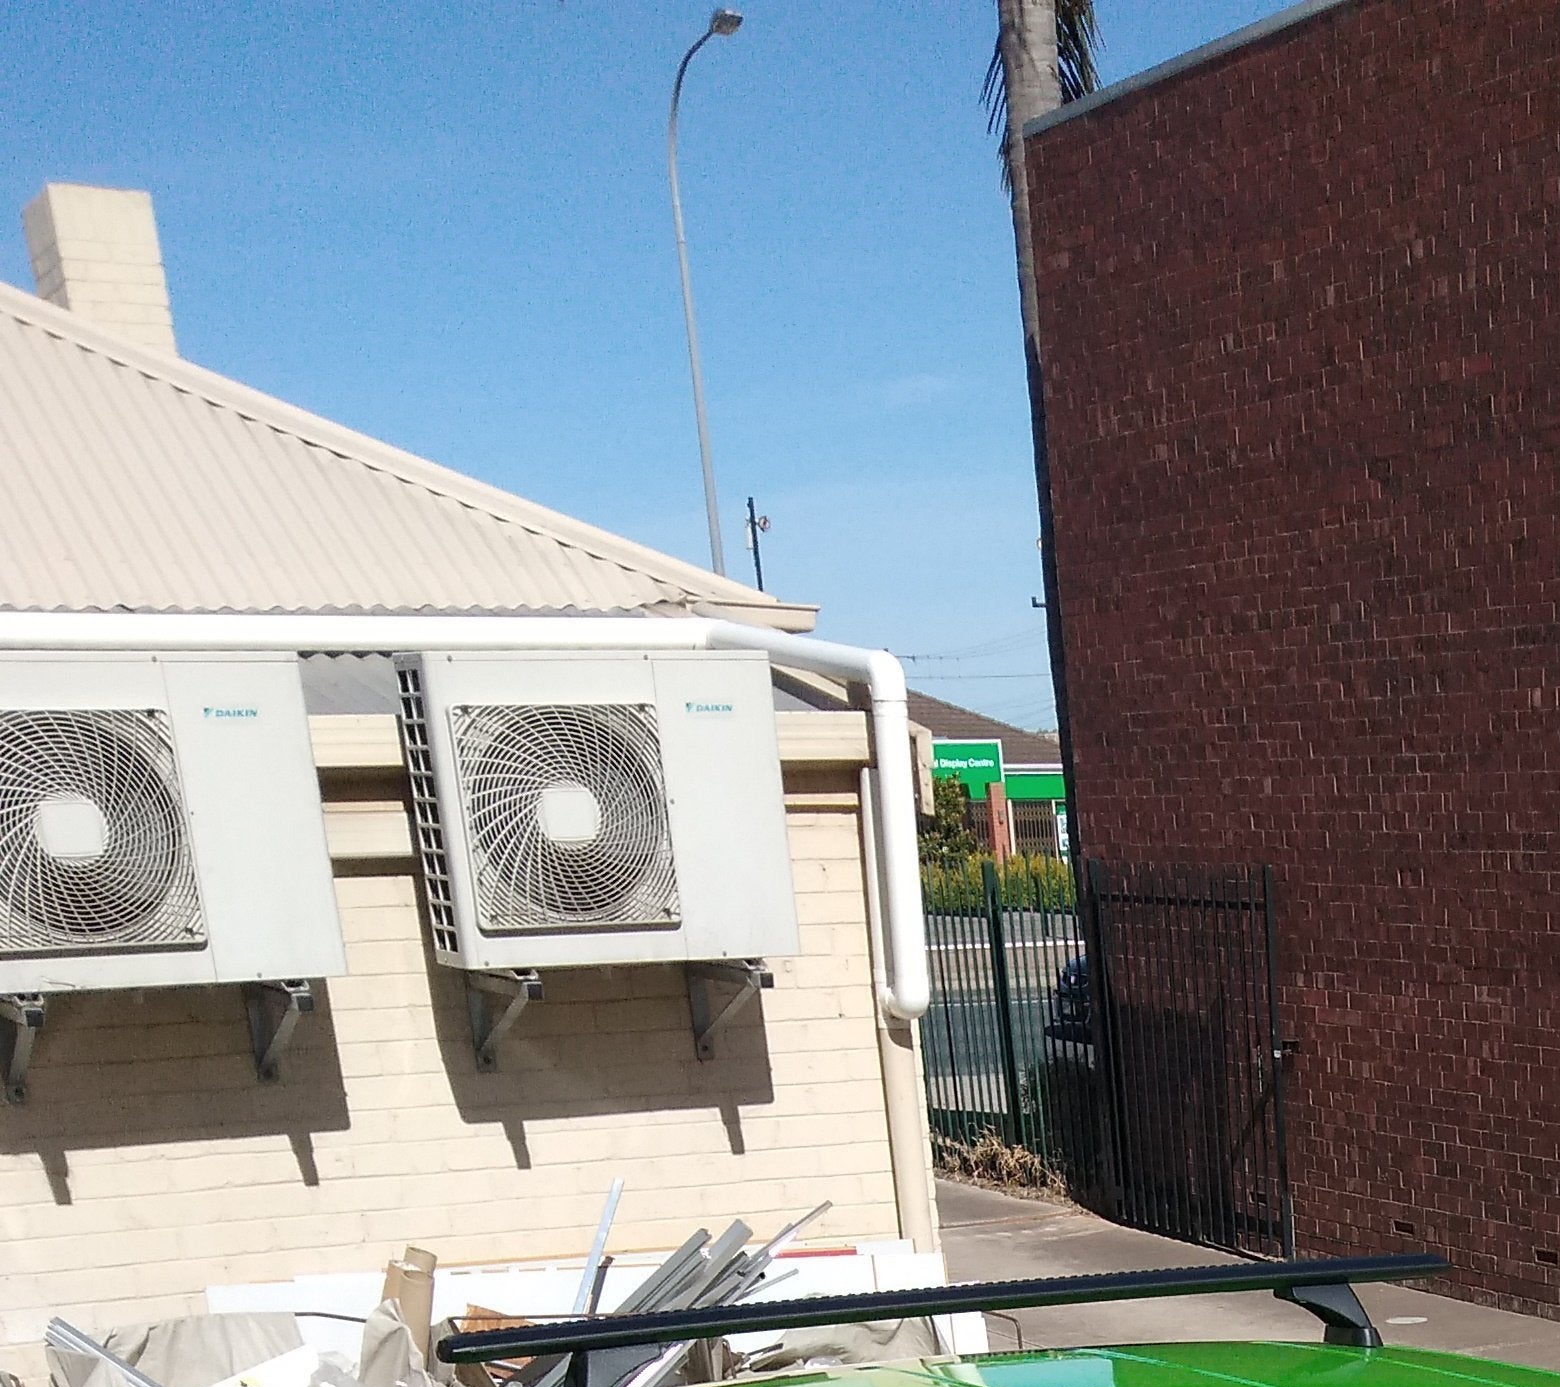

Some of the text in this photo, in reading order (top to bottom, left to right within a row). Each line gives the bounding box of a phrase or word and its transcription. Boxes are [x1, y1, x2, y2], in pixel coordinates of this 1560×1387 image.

[696, 703, 733, 712] DAIKIN
[215, 708, 258, 718] DAIKIN
[940, 758, 967, 769] Display
[968, 758, 994, 768] Centre
